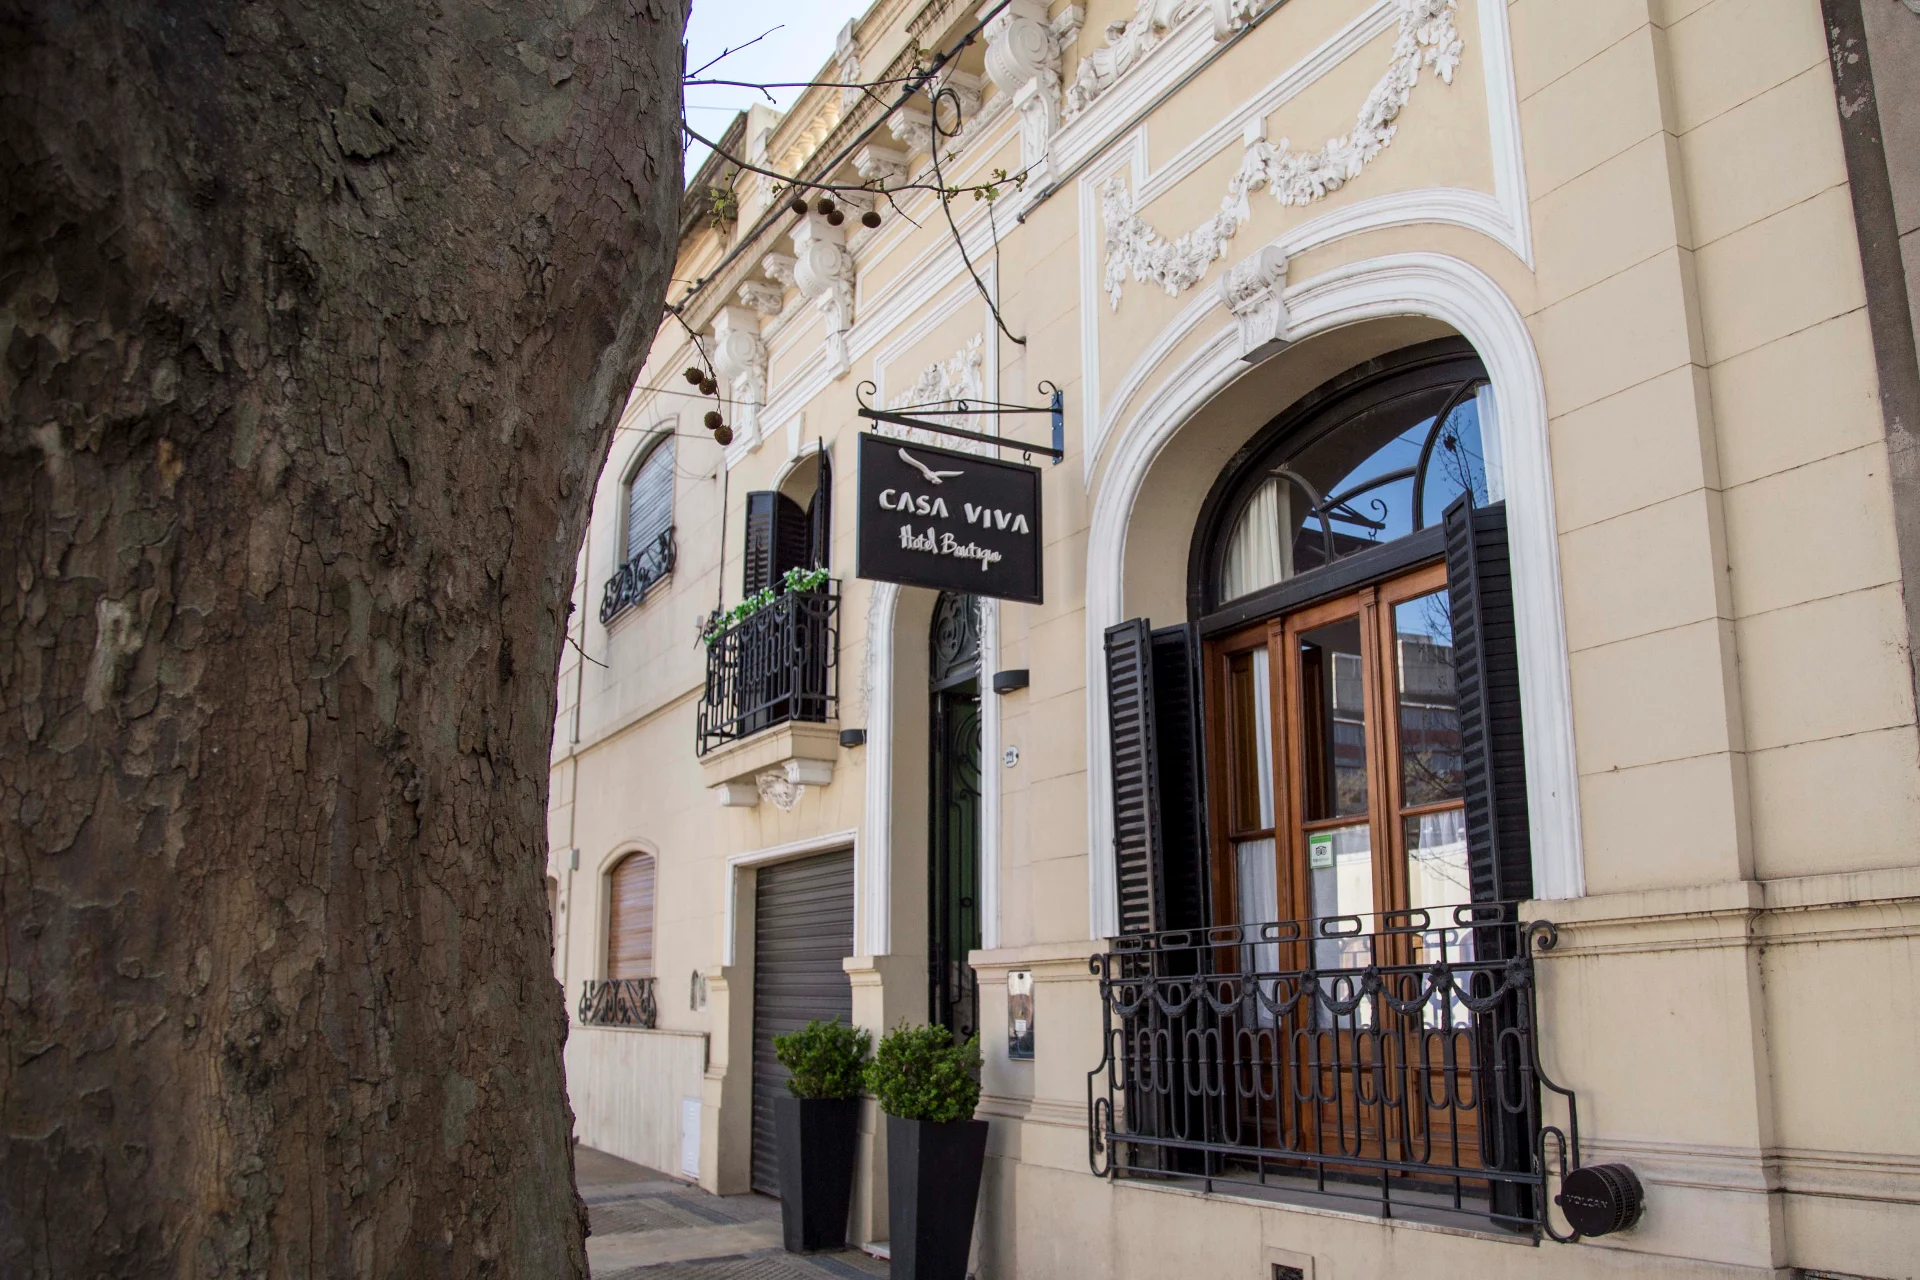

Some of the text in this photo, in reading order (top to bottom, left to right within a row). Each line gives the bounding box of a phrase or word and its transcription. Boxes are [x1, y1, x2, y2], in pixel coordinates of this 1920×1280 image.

[879, 489, 1029, 534] CASA VIVA
[899, 524, 1001, 571] Hotel Boutique
